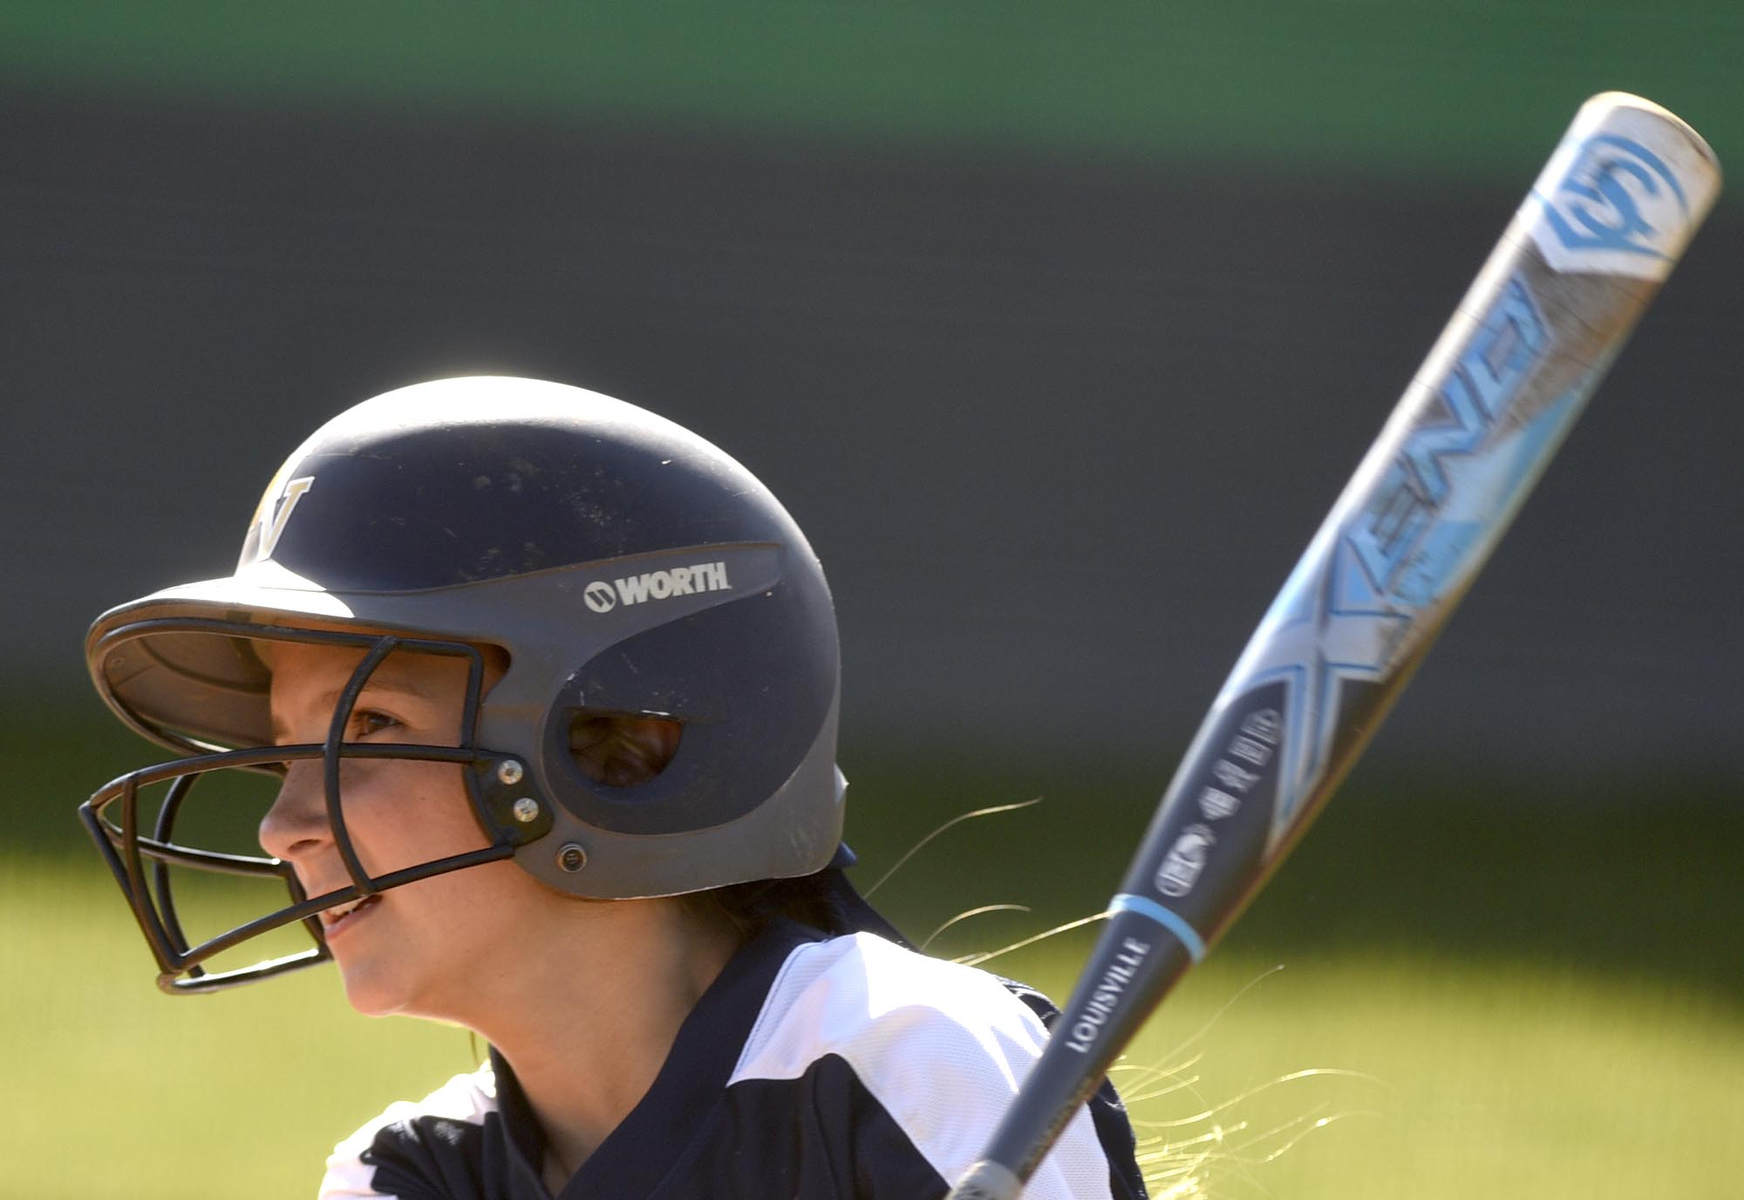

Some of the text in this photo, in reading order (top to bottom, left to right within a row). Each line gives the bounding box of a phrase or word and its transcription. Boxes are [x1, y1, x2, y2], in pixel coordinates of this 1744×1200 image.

[614, 561, 730, 606] WORTH
[1240, 272, 1552, 845] XENO
[1064, 936, 1151, 1053] LOUISVILLE
